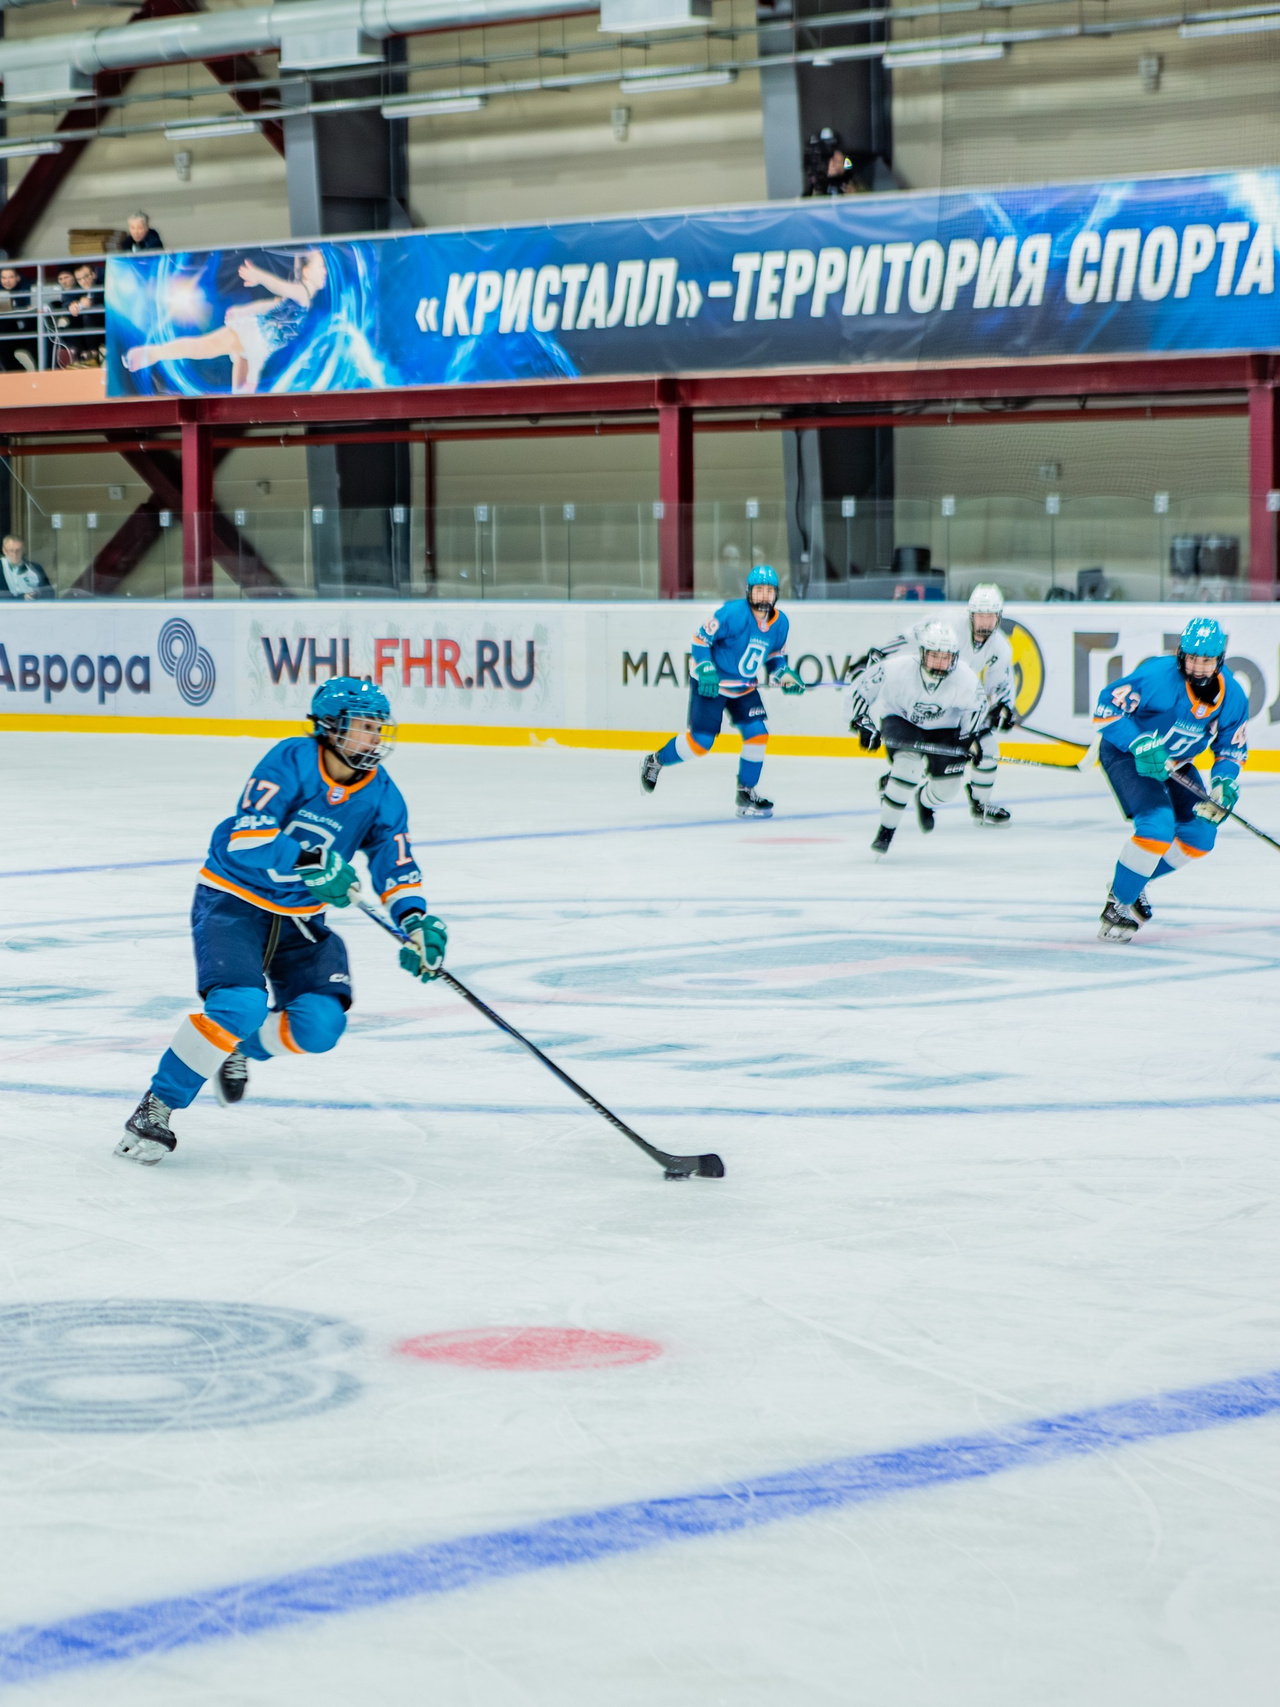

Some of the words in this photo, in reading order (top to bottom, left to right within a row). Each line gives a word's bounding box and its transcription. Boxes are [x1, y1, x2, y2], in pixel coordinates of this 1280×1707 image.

[1065, 221, 1275, 304] СПОРТА
[261, 636, 535, 690] WHL.FHR.RU
[242, 778, 280, 811] 17
